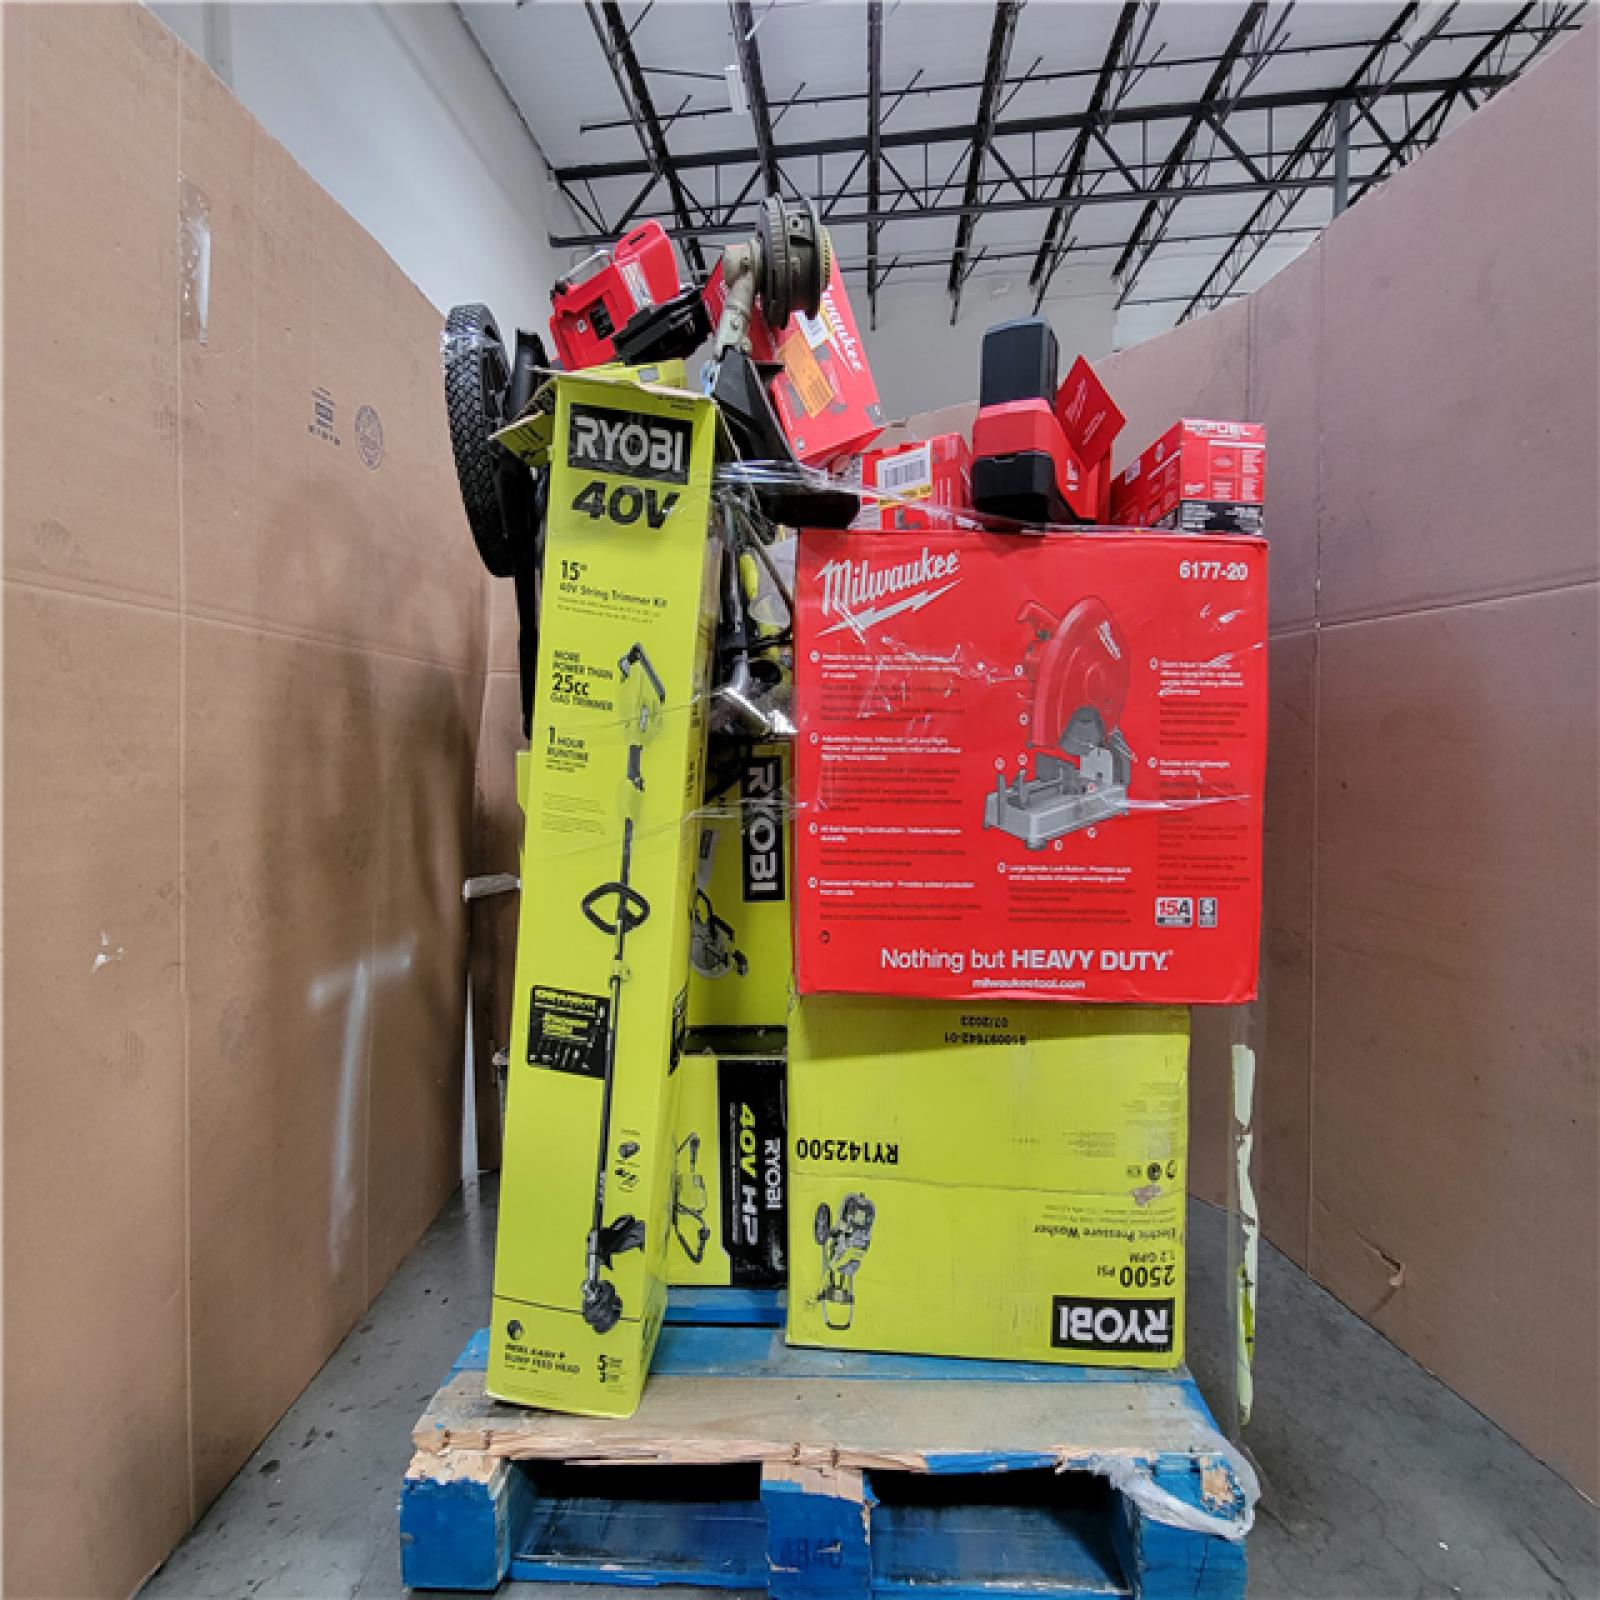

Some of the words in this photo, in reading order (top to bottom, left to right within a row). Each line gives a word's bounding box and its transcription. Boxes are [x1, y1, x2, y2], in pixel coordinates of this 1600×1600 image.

[574, 415, 685, 473] RYOBI
[572, 479, 681, 529] 40V
[813, 546, 961, 617] Milwaukee
[1179, 559, 1248, 581] 6177-20
[747, 763, 778, 892] RYOBI
[881, 947, 965, 974] Nothing
[971, 947, 1006, 970] but
[1010, 948, 1095, 971] HEAVY
[739, 1102, 757, 1178] 40V
[796, 1137, 899, 1166] RY142500
[764, 1136, 781, 1210] RYOBI
[741, 1184, 757, 1246] HP
[1096, 1264, 1116, 1277] PSI
[1118, 1264, 1176, 1288] 2500
[1057, 1304, 1170, 1345] RYOBI
